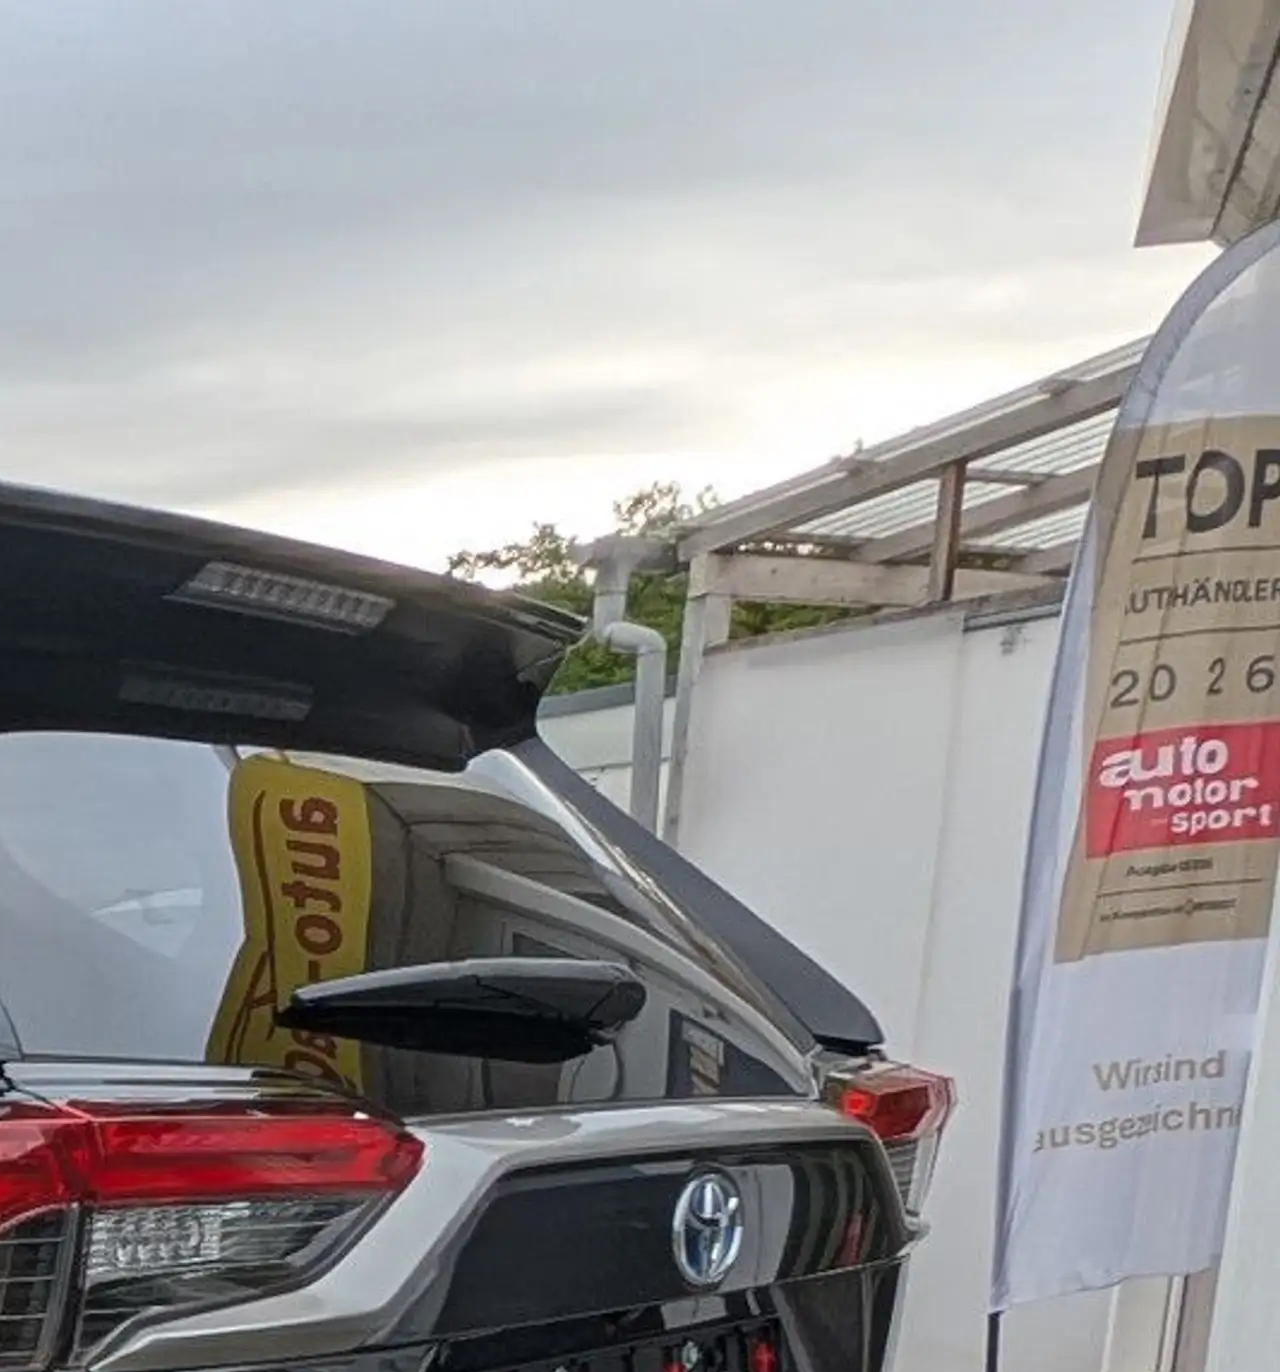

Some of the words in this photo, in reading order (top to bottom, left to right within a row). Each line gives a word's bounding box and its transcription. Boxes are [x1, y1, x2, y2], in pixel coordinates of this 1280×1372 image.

[1136, 448, 1280, 539] TOP
[1099, 735, 1229, 788] auto
[1170, 803, 1272, 837] sport
